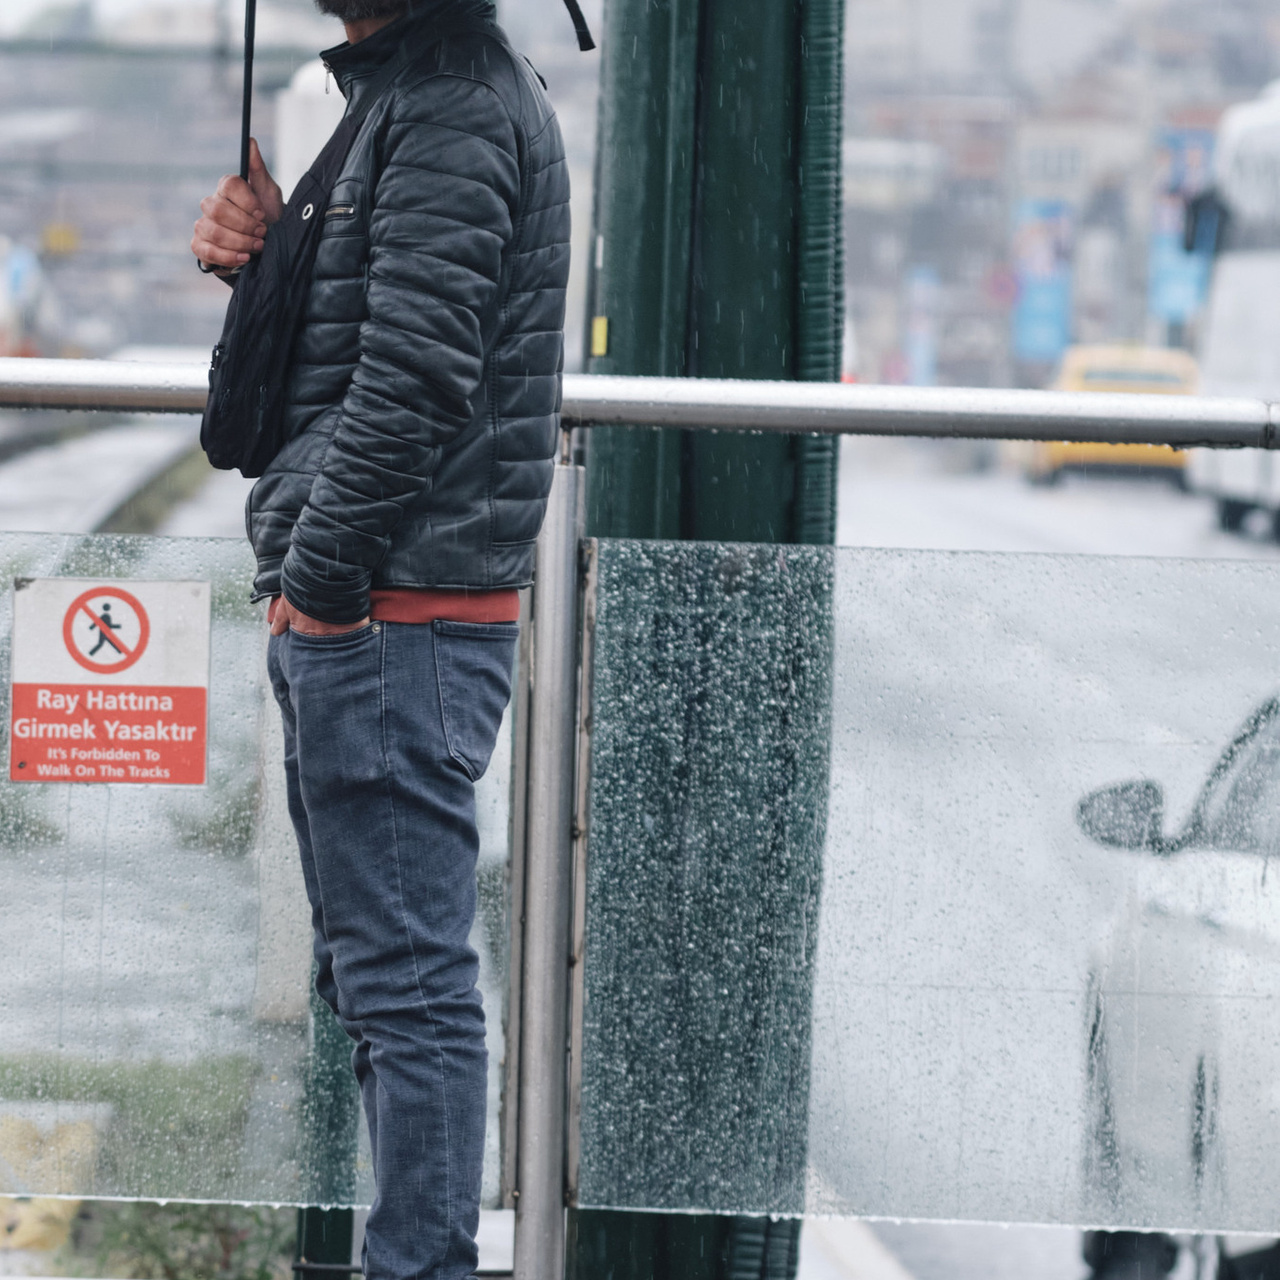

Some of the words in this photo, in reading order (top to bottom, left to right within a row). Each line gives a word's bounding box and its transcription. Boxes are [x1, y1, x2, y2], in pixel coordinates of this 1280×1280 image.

[37, 689, 80, 715] Ray
[86, 689, 173, 711] Hattına
[13, 717, 96, 739] Girmek
[103, 719, 197, 742] Yasaktır
[71, 747, 140, 761] Forbidden
[143, 748, 160, 762] To
[37, 763, 71, 776] Walk
[74, 764, 96, 776] On
[99, 764, 125, 777] The
[127, 765, 170, 778] Tracks
